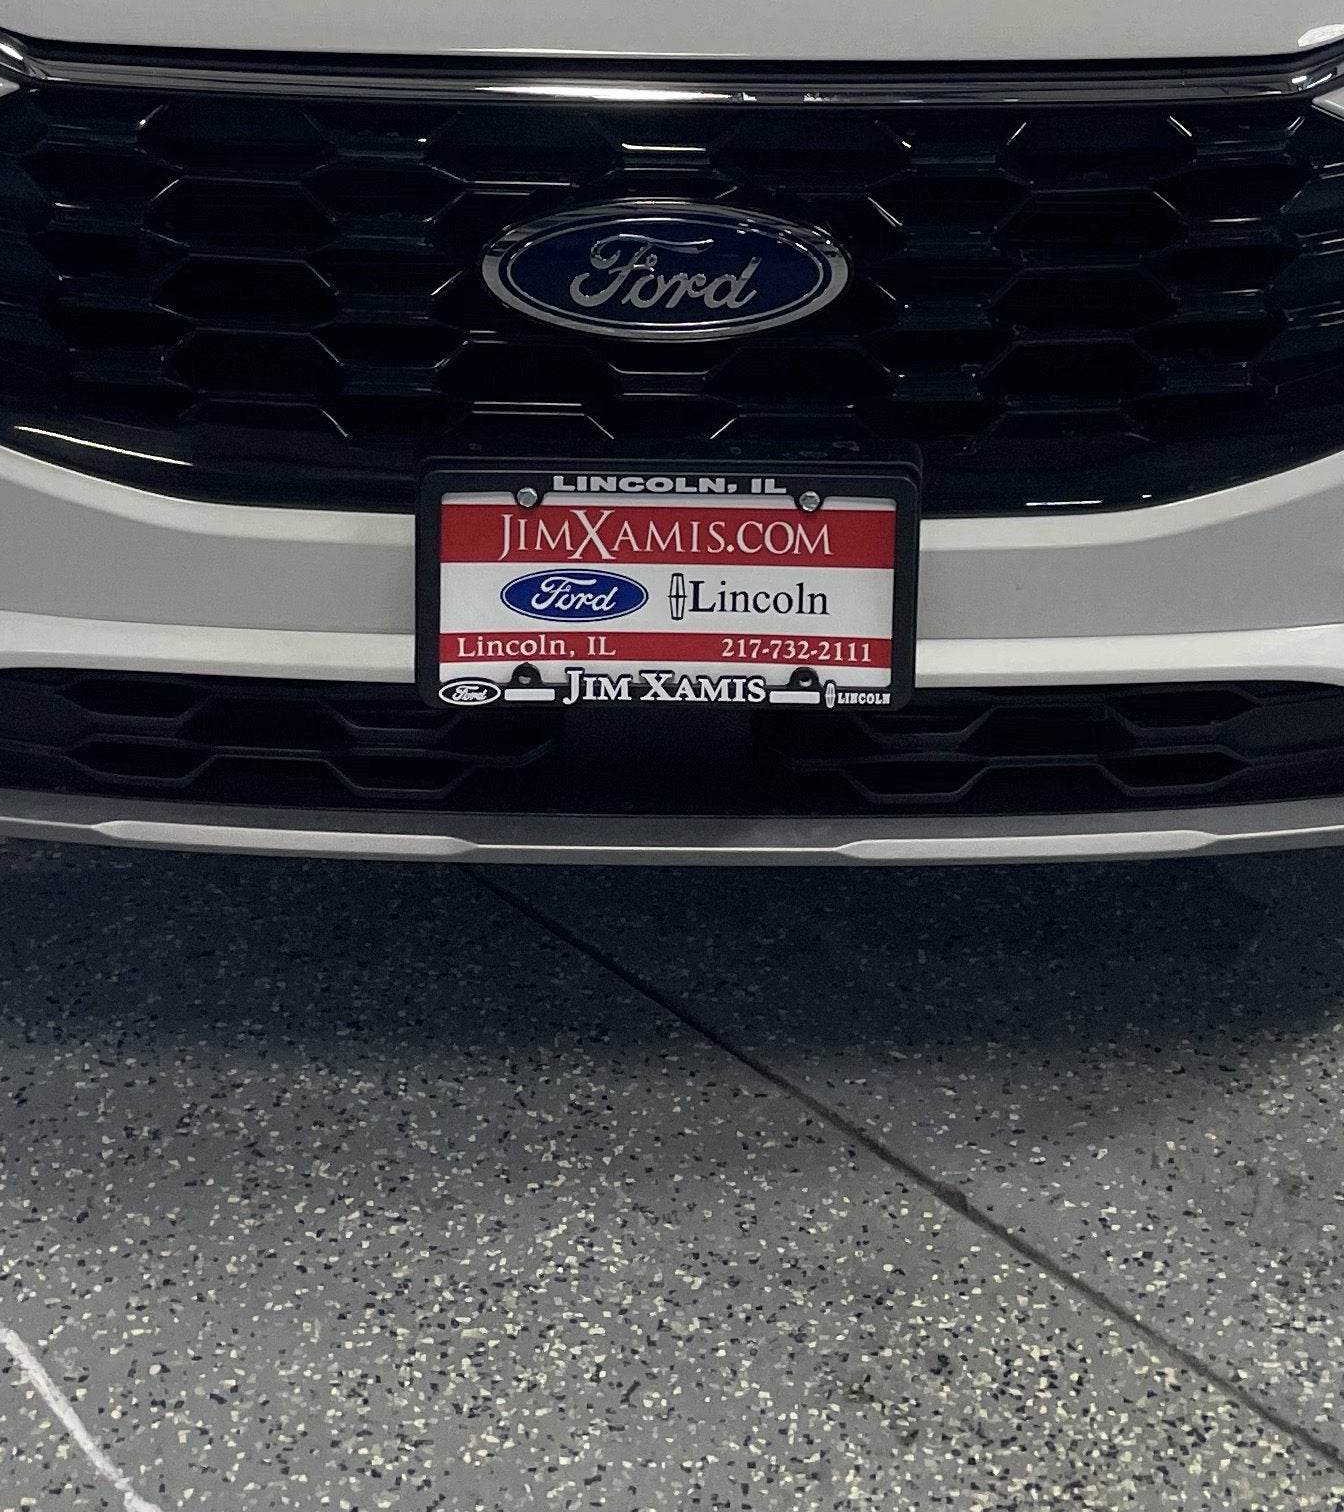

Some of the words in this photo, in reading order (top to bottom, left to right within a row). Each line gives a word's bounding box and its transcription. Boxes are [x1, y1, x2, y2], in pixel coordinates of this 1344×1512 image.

[570, 233, 761, 308] Ford
[553, 473, 737, 493] LINCOLN,
[751, 479, 786, 493] IL
[531, 577, 618, 611] Ford
[689, 581, 829, 614] Lincoln
[458, 634, 574, 657] Lincoln,
[588, 637, 616, 655] IL
[722, 639, 871, 661] 217-732-2111
[452, 686, 487, 700] Ford
[563, 670, 633, 705] JIM
[640, 673, 765, 702] XAMIS
[838, 693, 890, 704] LINCOLN
